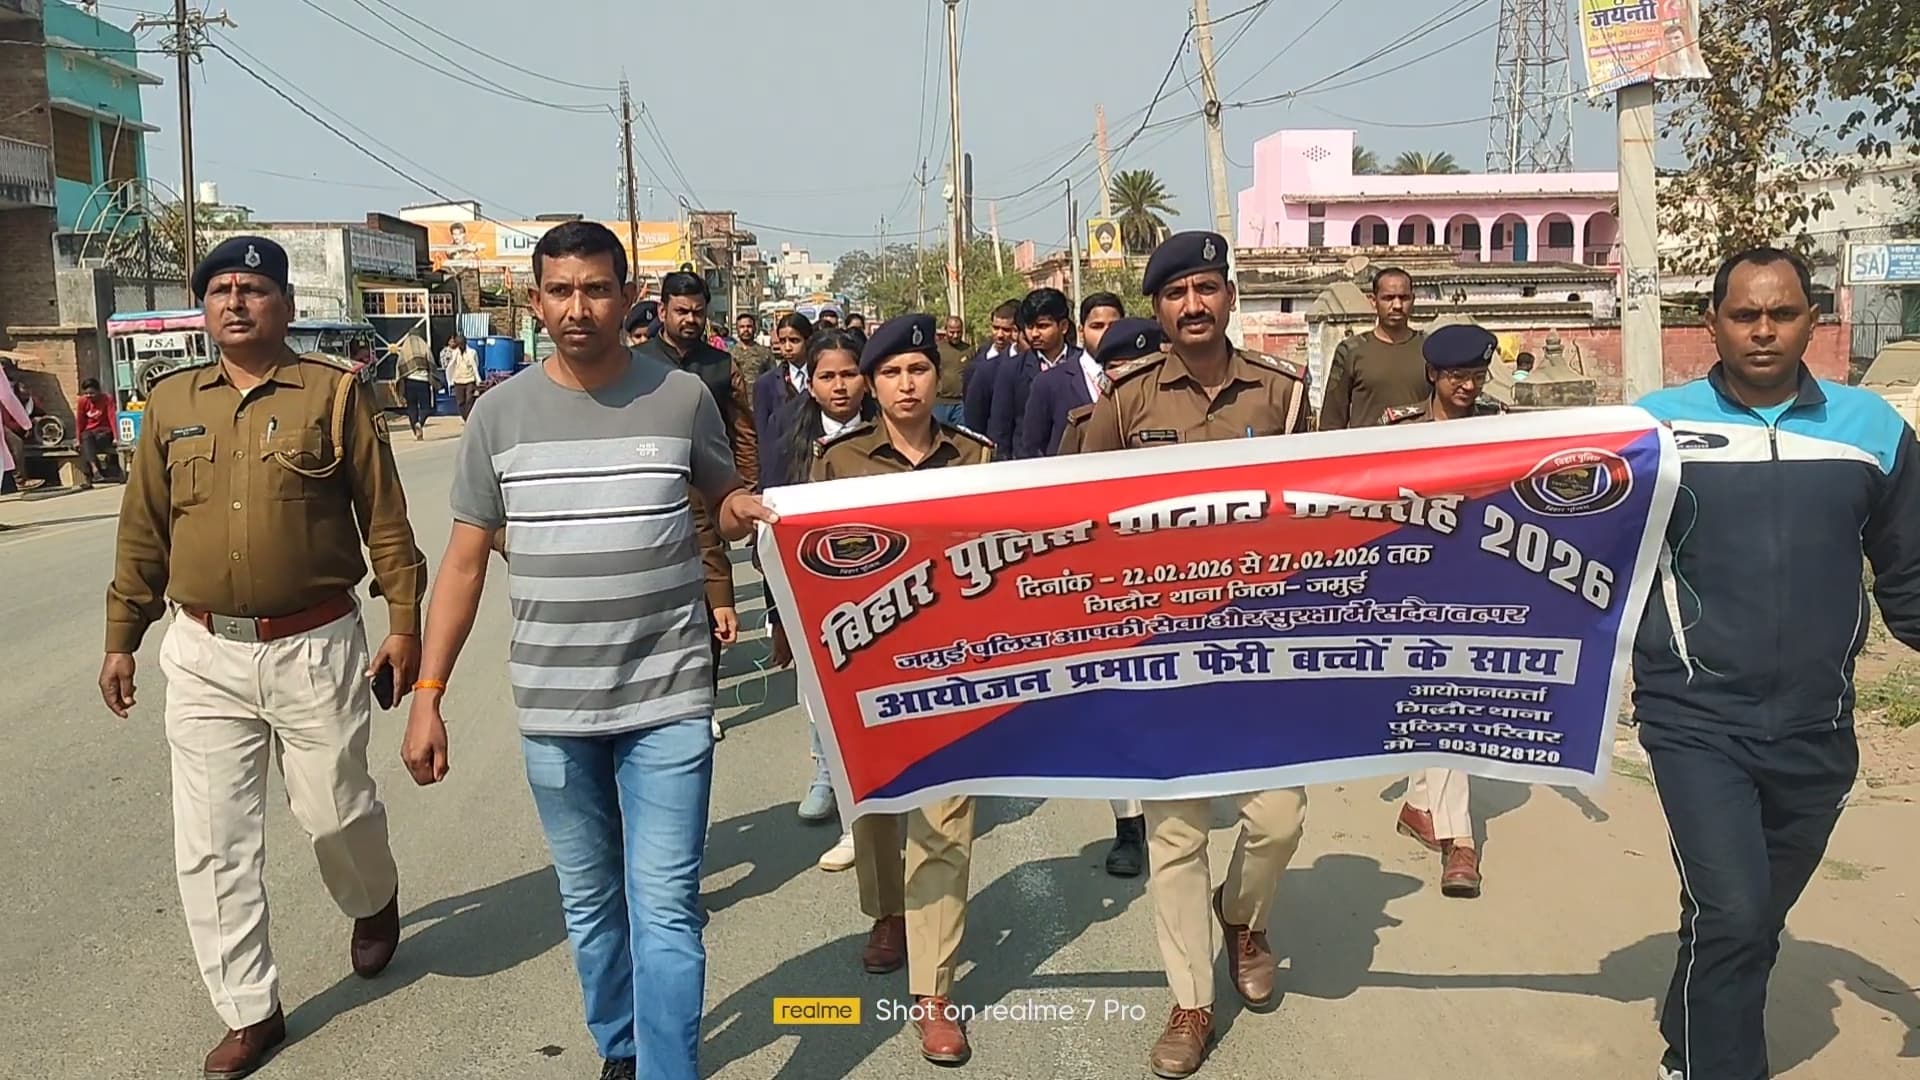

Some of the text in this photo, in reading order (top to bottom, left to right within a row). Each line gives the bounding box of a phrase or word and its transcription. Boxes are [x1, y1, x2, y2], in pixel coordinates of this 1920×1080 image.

[1855, 252, 1885, 275] SAI
[145, 338, 174, 348] JSA
[821, 557, 939, 670] बिहार
[945, 519, 1093, 597] पुलिस
[1480, 502, 1615, 611] 2026
[1015, 568, 1093, 598] दिनांक
[1122, 558, 1233, 586] 22.02.2026
[1239, 551, 1263, 574] से
[1268, 546, 1381, 572] 27.02.2026
[1386, 544, 1434, 564] तक
[1169, 586, 1223, 604] थाना
[1306, 570, 1369, 598] जमुई
[895, 641, 964, 670] जमुई
[1053, 618, 1148, 647] आपकी
[874, 636, 1564, 718] आयोजन प्रभात फेरी बच्चों के साथ
[1388, 718, 1563, 744] पुलिस परिवार
[1488, 706, 1553, 723] थाना
